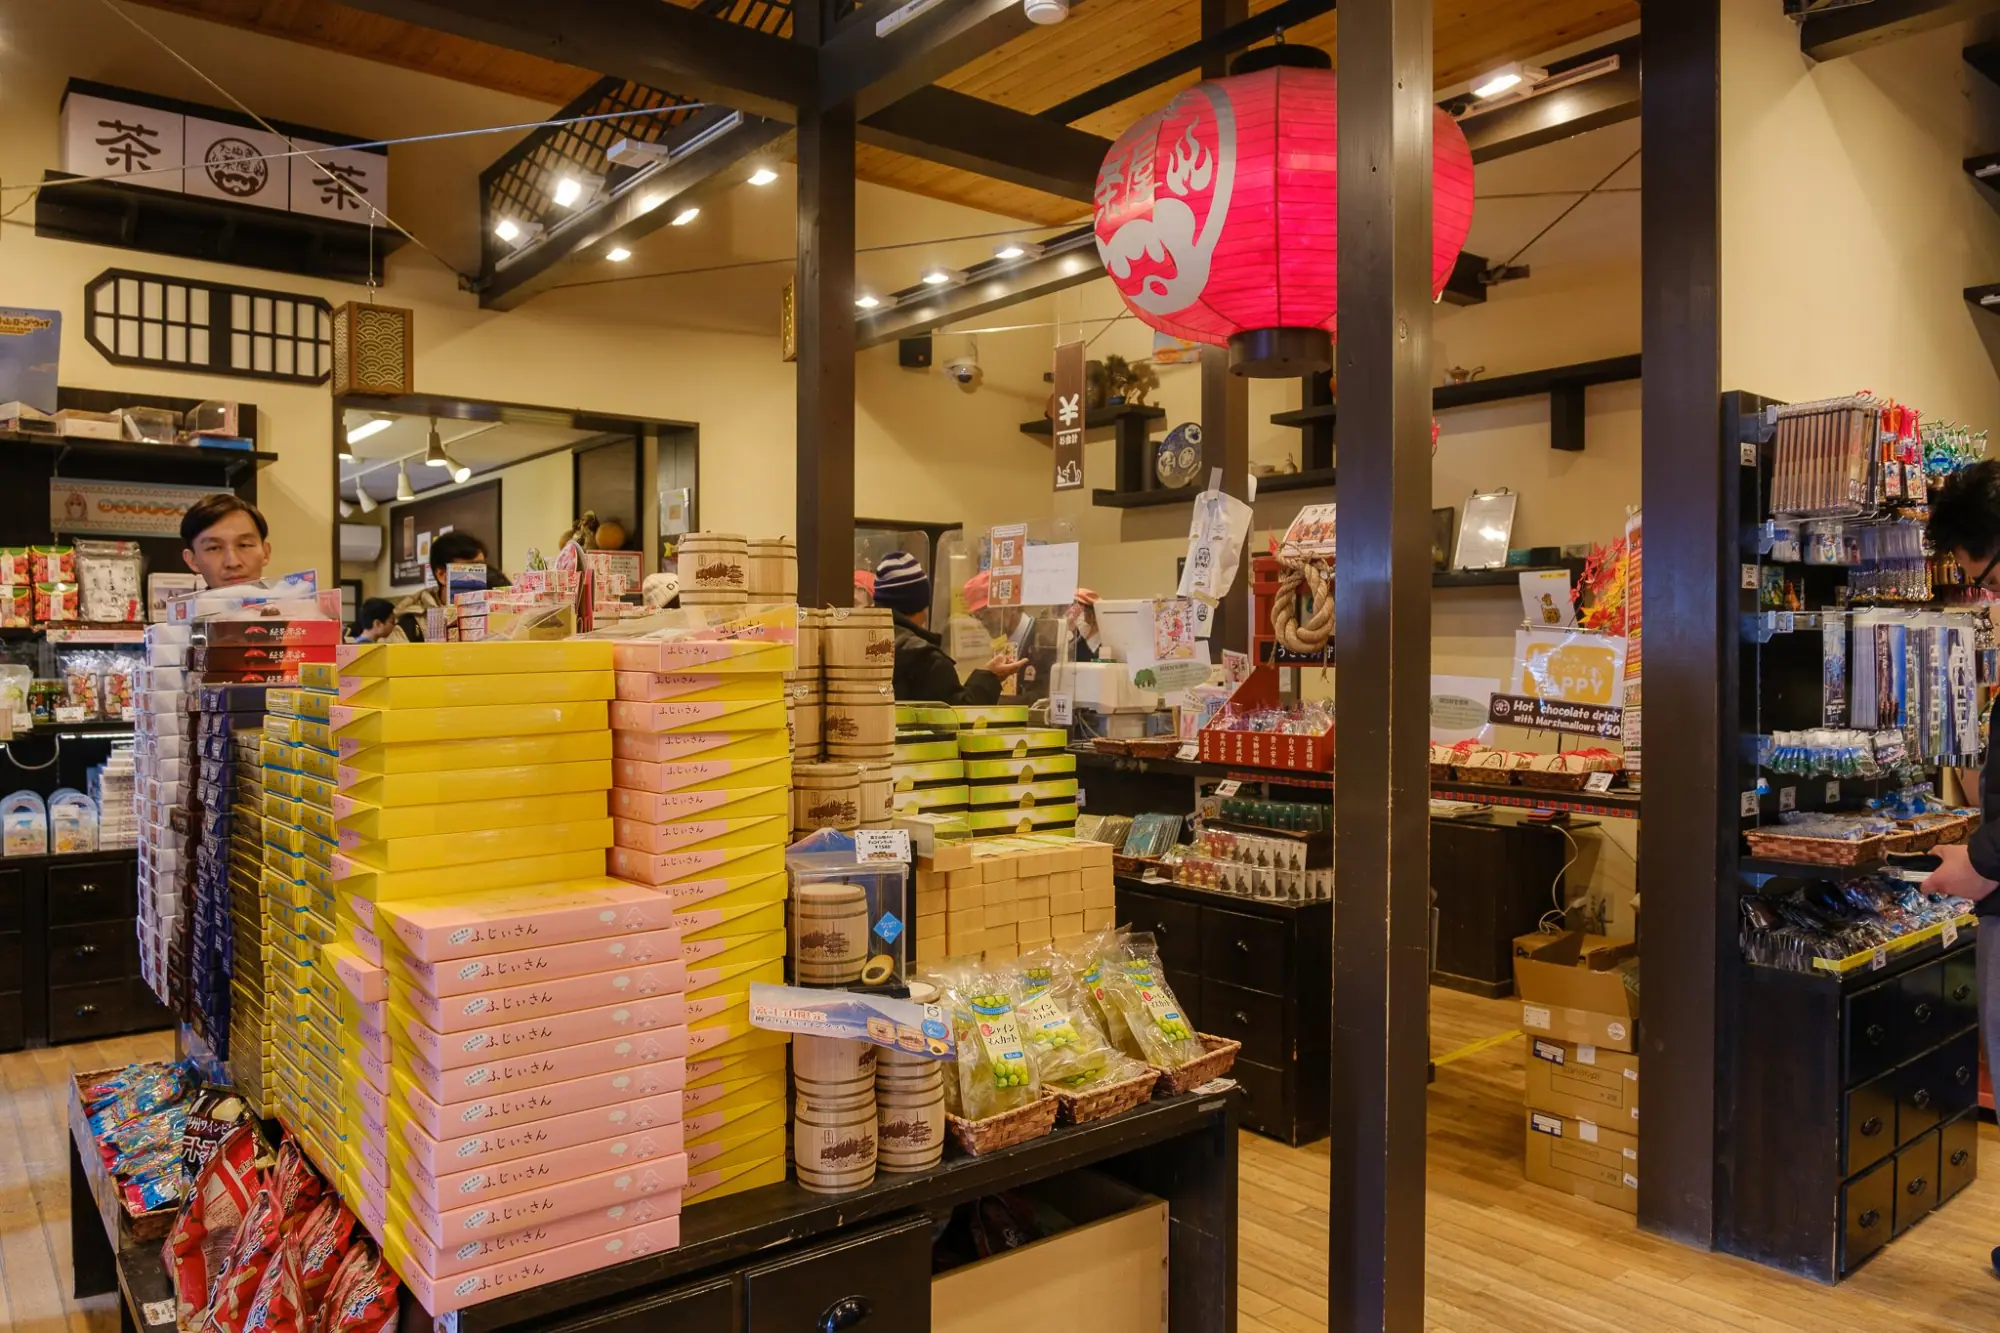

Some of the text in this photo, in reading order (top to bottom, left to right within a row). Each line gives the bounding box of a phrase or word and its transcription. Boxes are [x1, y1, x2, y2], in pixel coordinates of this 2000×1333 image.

[95, 119, 162, 173] 茶
[312, 161, 369, 211] 茶
[1059, 393, 1079, 426] ¥
[667, 646, 709, 656] ふじぃさん
[654, 676, 696, 685] ふじぃさん
[1536, 676, 1604, 697] APPY
[658, 706, 701, 715] ふじぃさん
[1513, 700, 1621, 723] Hot chocolate drink
[1513, 714, 1534, 725] with
[1535, 716, 1596, 732] Marshmallows
[664, 735, 706, 745] ふじぃさん
[666, 765, 708, 776] ふじぃさん
[662, 796, 704, 807] ふじぃさん
[662, 826, 704, 837] ふじぃさん
[661, 855, 702, 867] ふじぃさん
[665, 885, 704, 897] じぃさん
[472, 922, 539, 943] ふじぃさん
[481, 956, 548, 977] ふじぃさん
[486, 990, 553, 1013] ふじぃさん
[1032, 1003, 1053, 1013] ャイン
[485, 1026, 552, 1048] ふじぃさん
[987, 1033, 1018, 1045] マスカット
[990, 1023, 1015, 1035] シャイン
[487, 1059, 554, 1082] ふじぃさん
[484, 1094, 552, 1117] ふじぃさん
[480, 1128, 548, 1152] ふじぃさん
[482, 1162, 550, 1187] ふじぃさん
[487, 1197, 554, 1224] ふじぃさん
[480, 1228, 547, 1255] ふじぃさん
[477, 1263, 545, 1291] ふじぃさん
